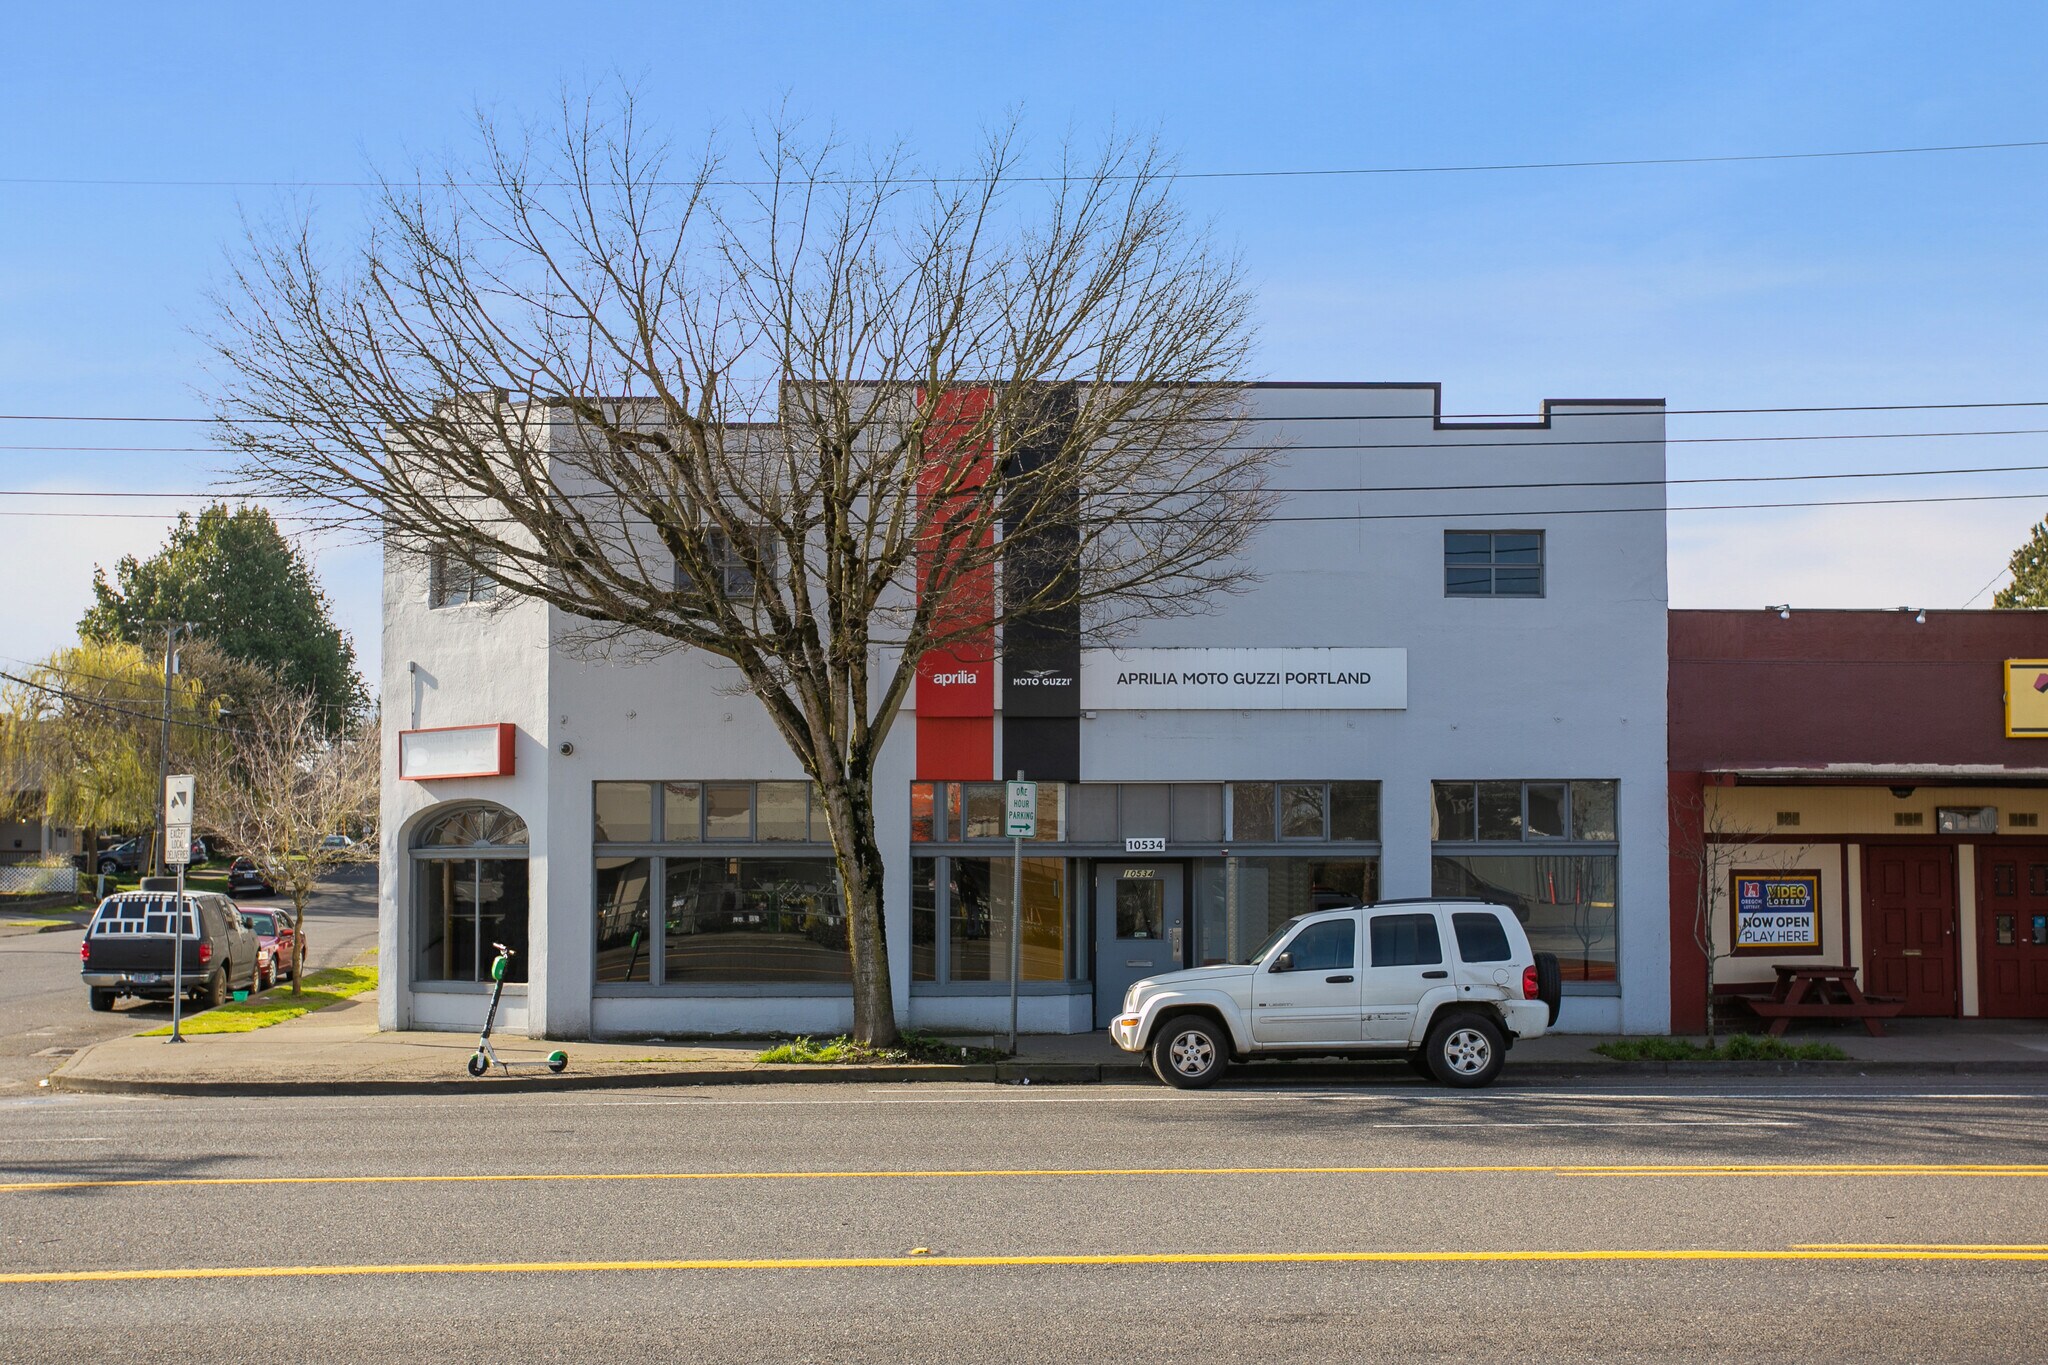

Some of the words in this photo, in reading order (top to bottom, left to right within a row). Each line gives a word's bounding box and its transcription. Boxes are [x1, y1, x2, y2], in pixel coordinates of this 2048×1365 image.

[933, 670, 977, 686] aprilia
[1013, 678, 1039, 686] MOTO
[1042, 678, 1070, 686] GUZZI
[1116, 672, 1178, 685] APRILIA
[1182, 672, 1229, 685] MOTO
[1233, 672, 1281, 685] GUZZI
[1285, 672, 1371, 685] PORTLAND
[1016, 787, 1028, 796] ONE
[1013, 799, 1030, 808] HOUR
[1008, 811, 1034, 820] PARKING
[170, 828, 187, 839] EXCEPT
[171, 839, 185, 849] LOCAL
[1127, 840, 1164, 850] 10534
[166, 850, 189, 860] DELIVERIES
[1124, 870, 1154, 878] 10534
[1767, 886, 1806, 898] VIDEO
[1743, 917, 1774, 928] NOW
[1776, 917, 1810, 928] OPEN
[1745, 930, 1775, 942] PLAY
[1777, 930, 1809, 942] HERE
